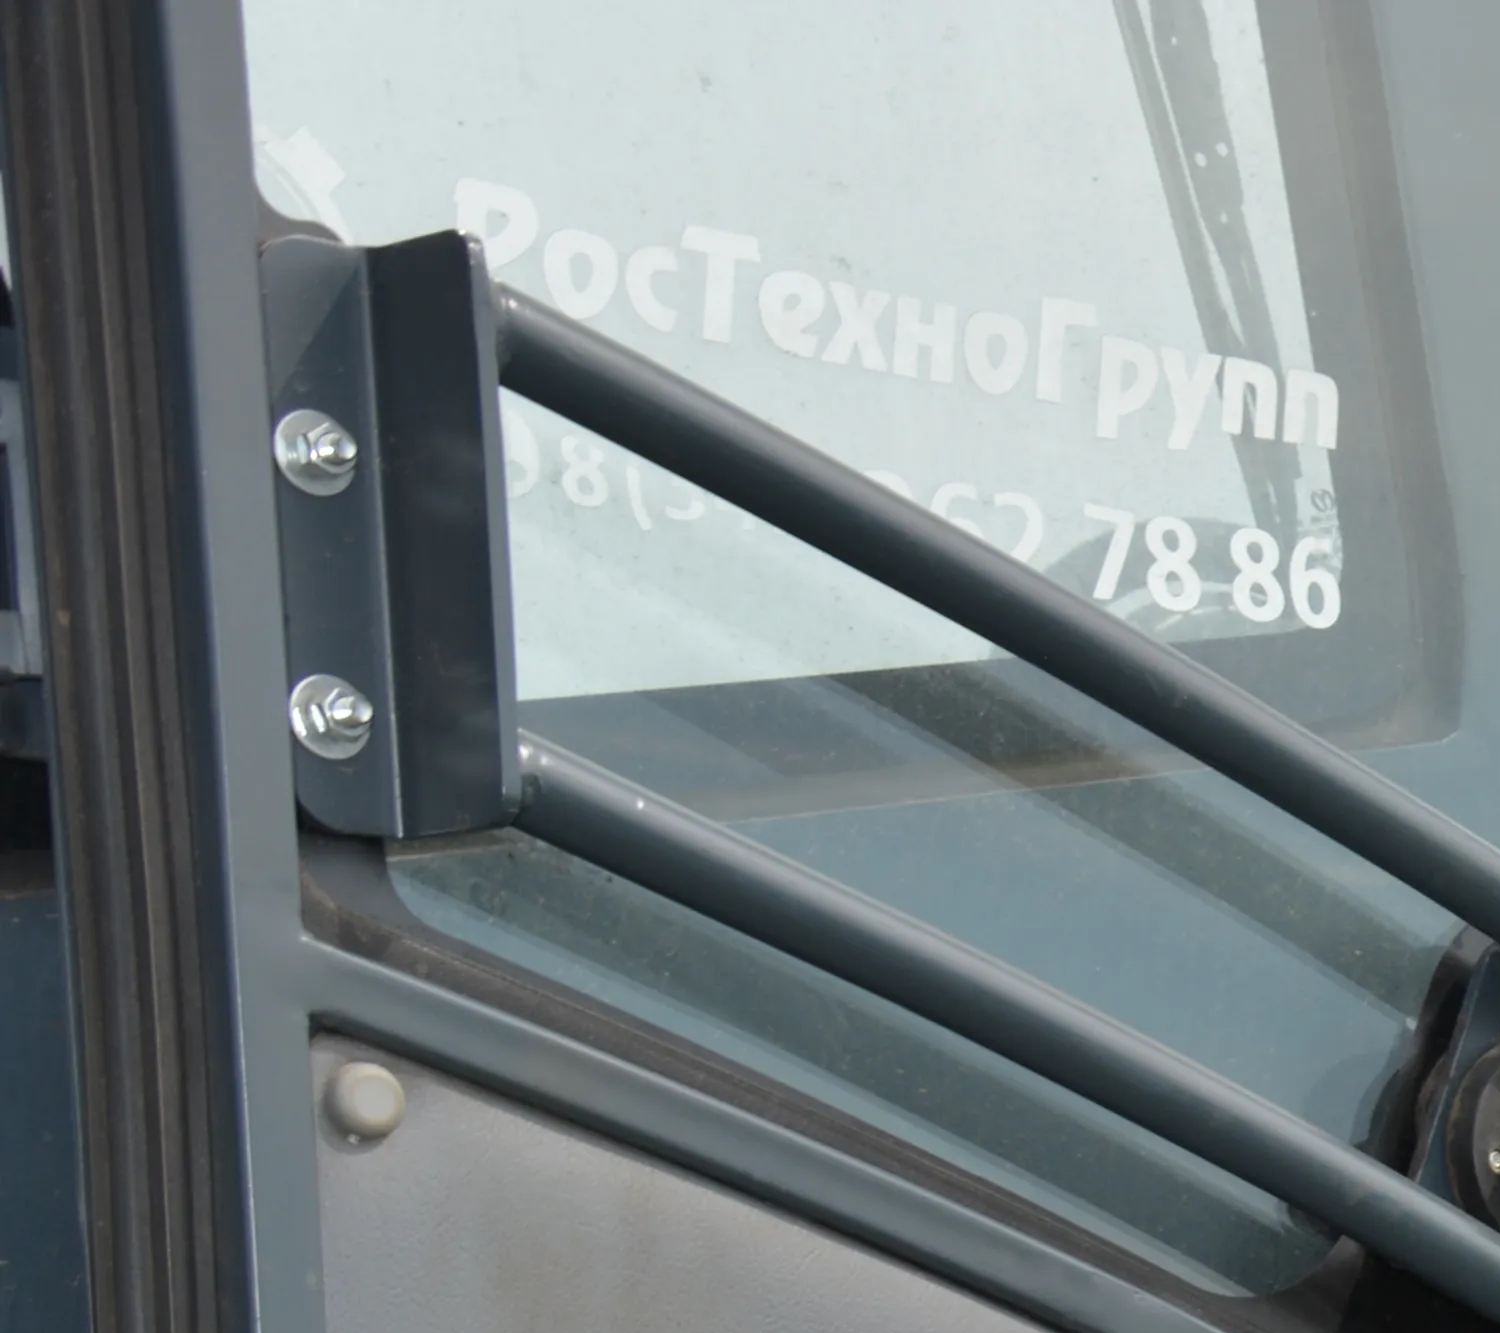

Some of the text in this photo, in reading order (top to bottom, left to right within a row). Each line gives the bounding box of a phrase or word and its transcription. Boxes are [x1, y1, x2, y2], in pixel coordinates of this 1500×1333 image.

[453, 178, 1340, 450] РосТехноГрупп
[1083, 504, 1200, 613] 78
[1229, 526, 1341, 629] 86
